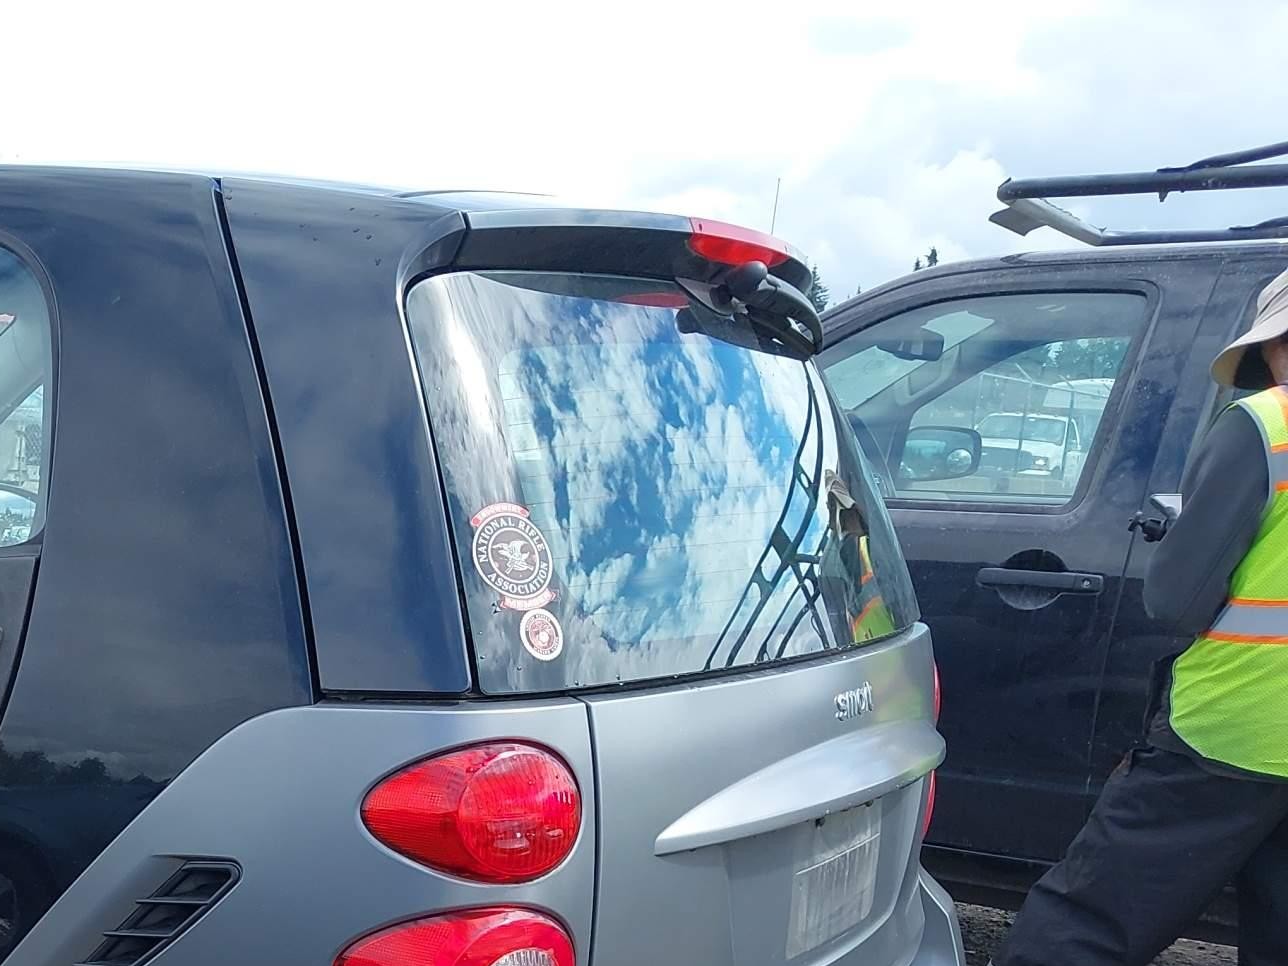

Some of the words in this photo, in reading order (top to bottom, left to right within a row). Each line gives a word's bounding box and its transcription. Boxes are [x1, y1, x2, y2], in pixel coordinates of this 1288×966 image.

[477, 517, 516, 563] NATIONAL
[518, 519, 545, 552] RIFLE
[488, 561, 548, 595] ASSOCIATION
